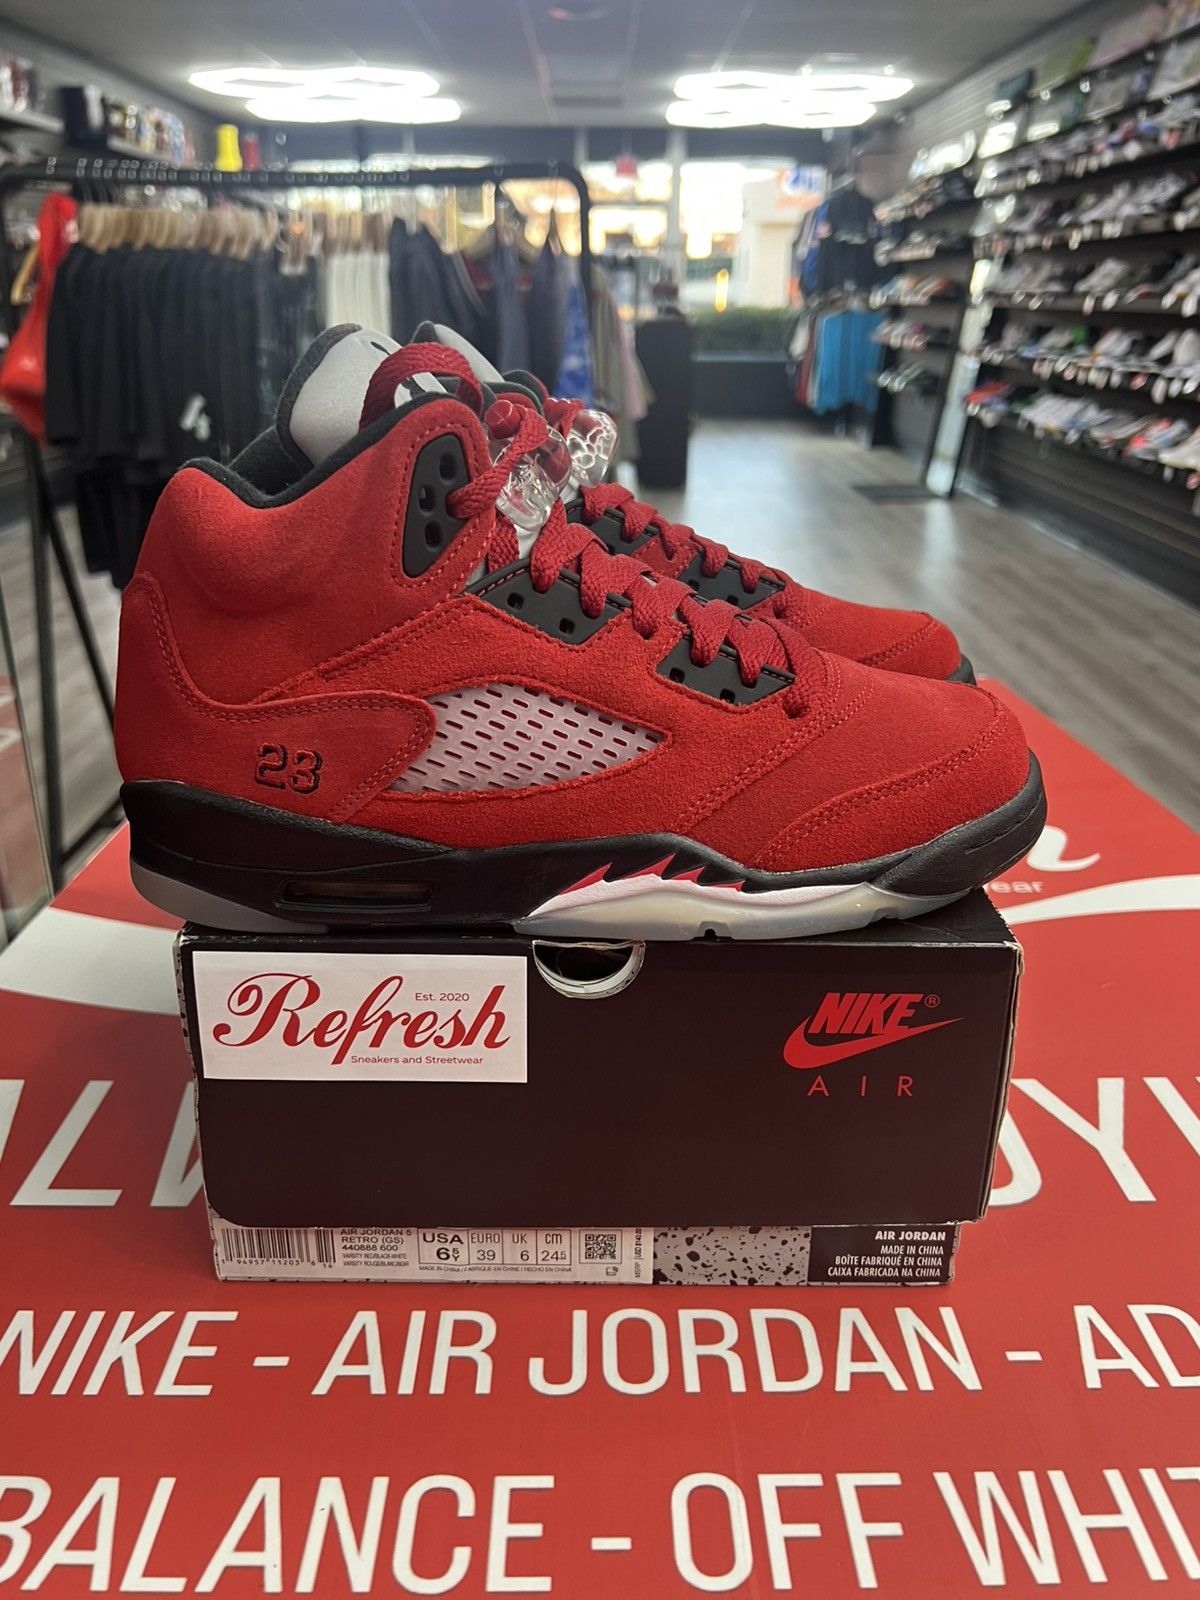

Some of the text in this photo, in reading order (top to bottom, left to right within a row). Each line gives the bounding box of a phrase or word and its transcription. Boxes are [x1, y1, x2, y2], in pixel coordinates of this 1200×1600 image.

[254, 742, 323, 795] 23
[415, 992, 470, 1001] Est. 2020
[212, 973, 511, 1065] Refresh
[351, 1055, 483, 1065] Sneakers and Streetwear
[807, 1074, 914, 1097] AIR
[382, 1236, 404, 1244] (GS)
[423, 1233, 464, 1244] USA
[471, 1233, 500, 1243] EURO
[512, 1233, 527, 1243] UK
[875, 1231, 946, 1240] AIR JORDAN
[477, 1249, 496, 1260] 39
[520, 1250, 530, 1261] 6
[880, 1245, 944, 1255] MADE IN CHINA
[835, 1254, 859, 1265] BOÎTE
[904, 1256, 914, 1265] EN
[917, 1256, 942, 1266] CHINA
[828, 1267, 941, 1277] CAIXA FABRICADA NA CHINA
[0, 1310, 238, 1396] NIKE
[311, 1310, 497, 1395] AIR
[528, 1307, 983, 1396] JORDAN
[671, 1472, 904, 1592] OFF
